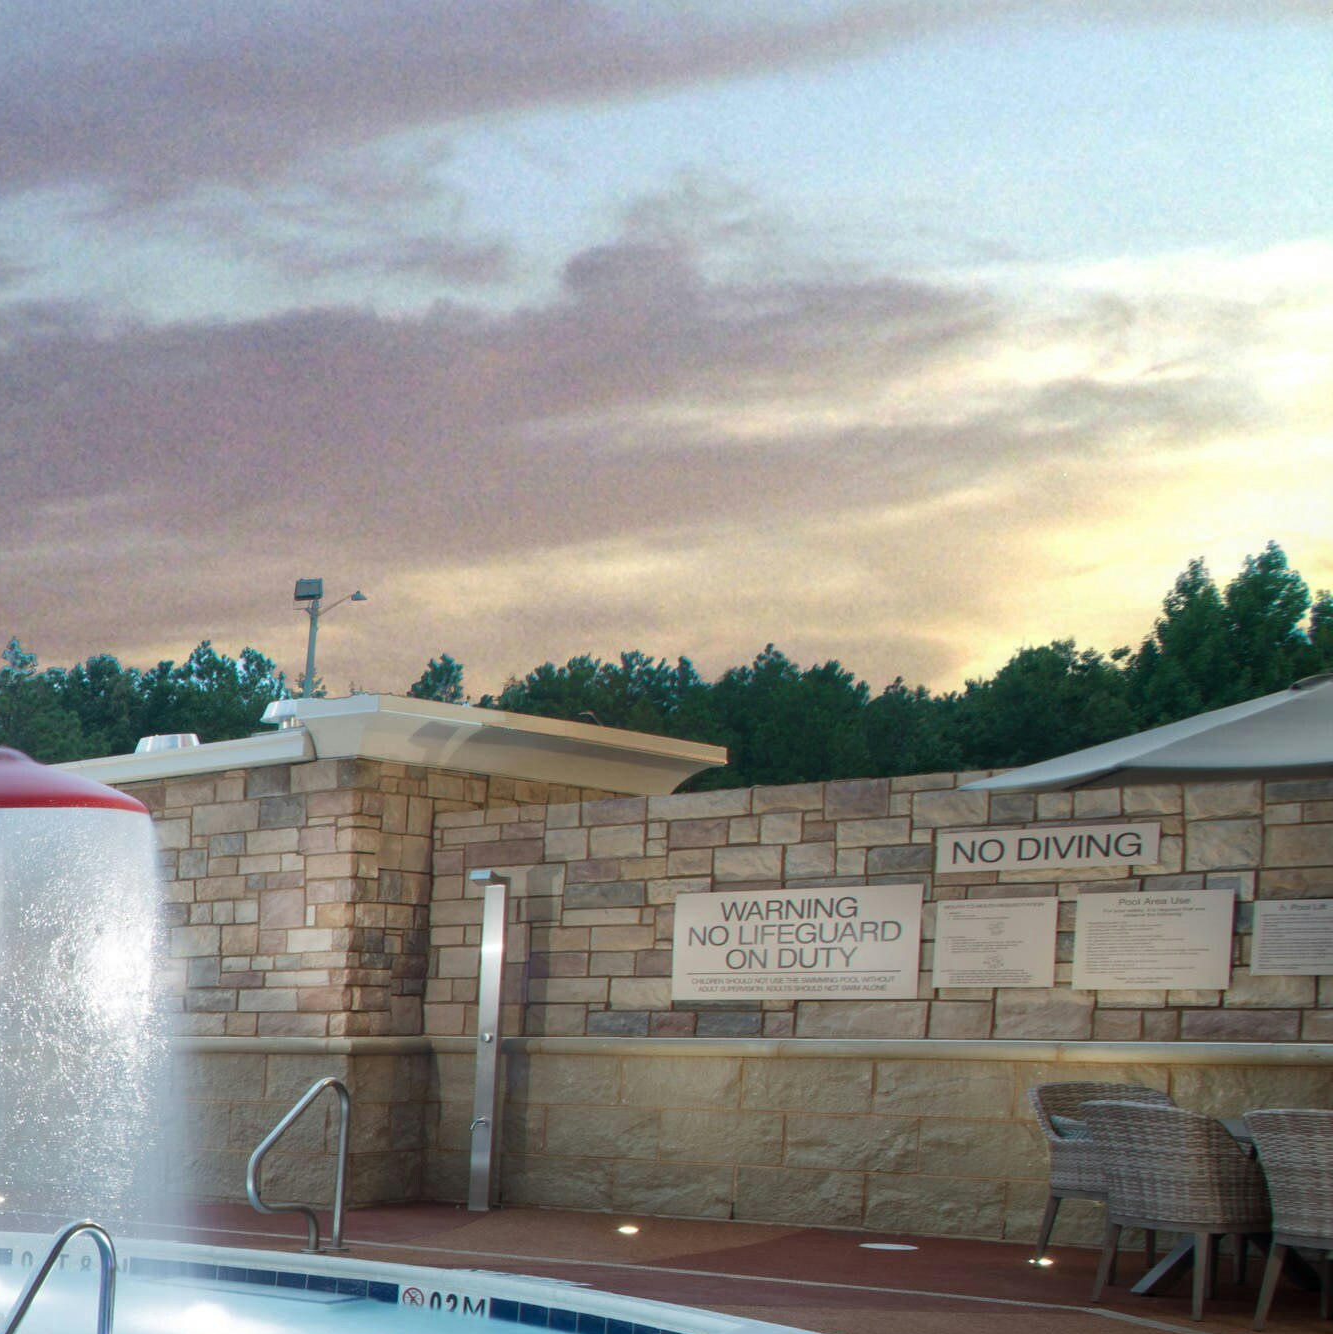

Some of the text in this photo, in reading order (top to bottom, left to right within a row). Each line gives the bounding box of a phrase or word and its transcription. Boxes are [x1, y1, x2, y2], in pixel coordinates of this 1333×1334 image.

[952, 832, 1142, 864] NO DIVING
[721, 897, 858, 921] WARNING
[688, 920, 902, 946] NO LIFEGUARD
[725, 946, 858, 970] ON DUTY
